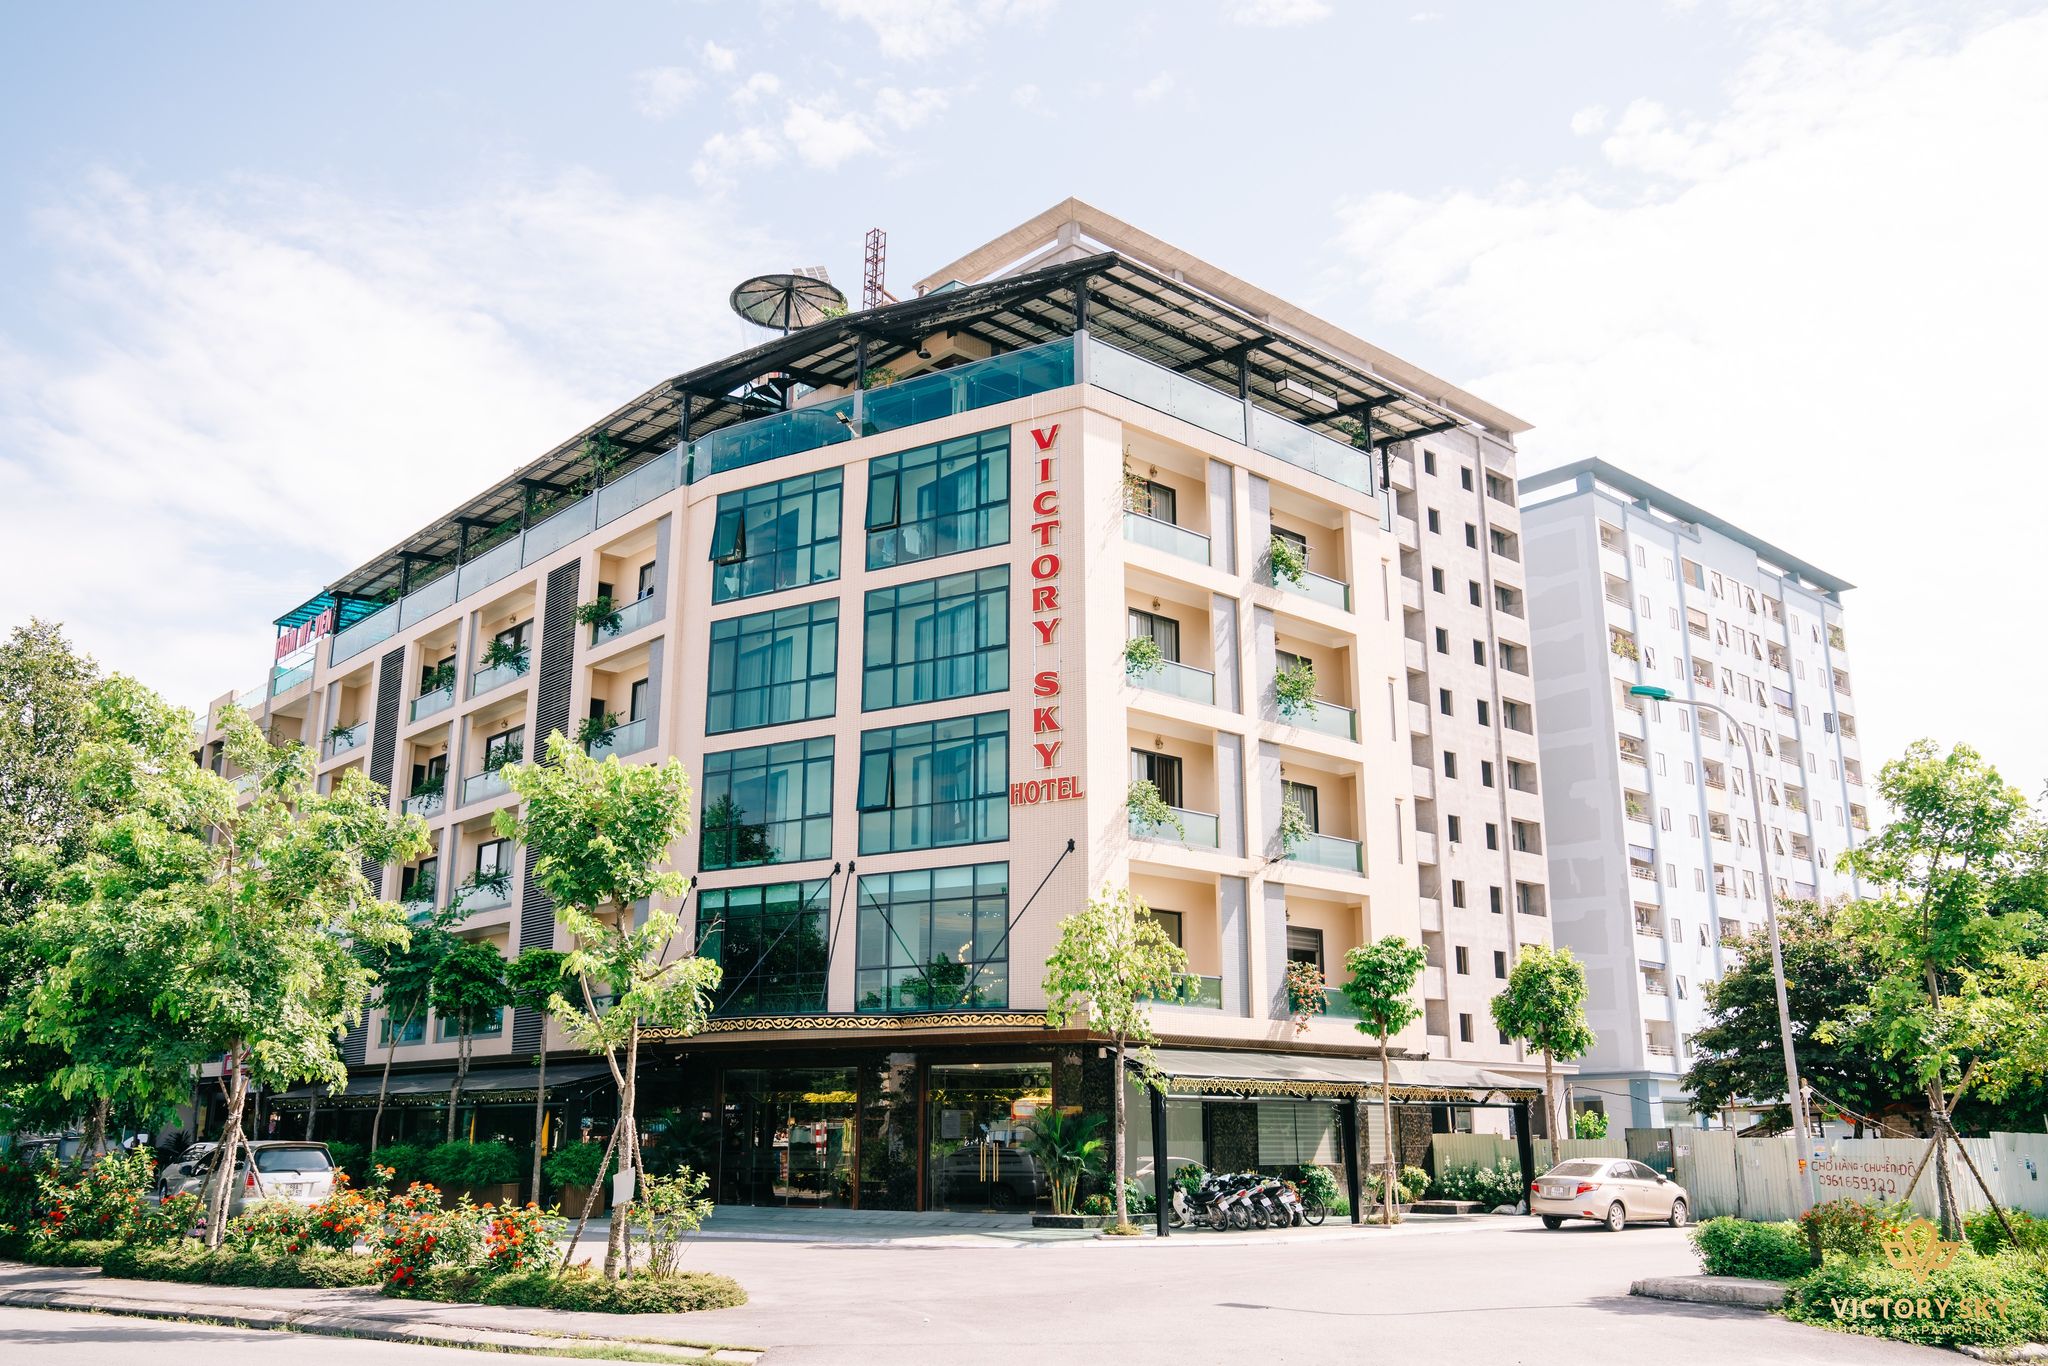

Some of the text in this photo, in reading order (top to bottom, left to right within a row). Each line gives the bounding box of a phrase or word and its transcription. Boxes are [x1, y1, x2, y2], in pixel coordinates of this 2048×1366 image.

[1030, 423, 1062, 768] VICTORY SKY
[1010, 775, 1084, 806] HOTEL
[1811, 1155, 1833, 1172] CHỞ
